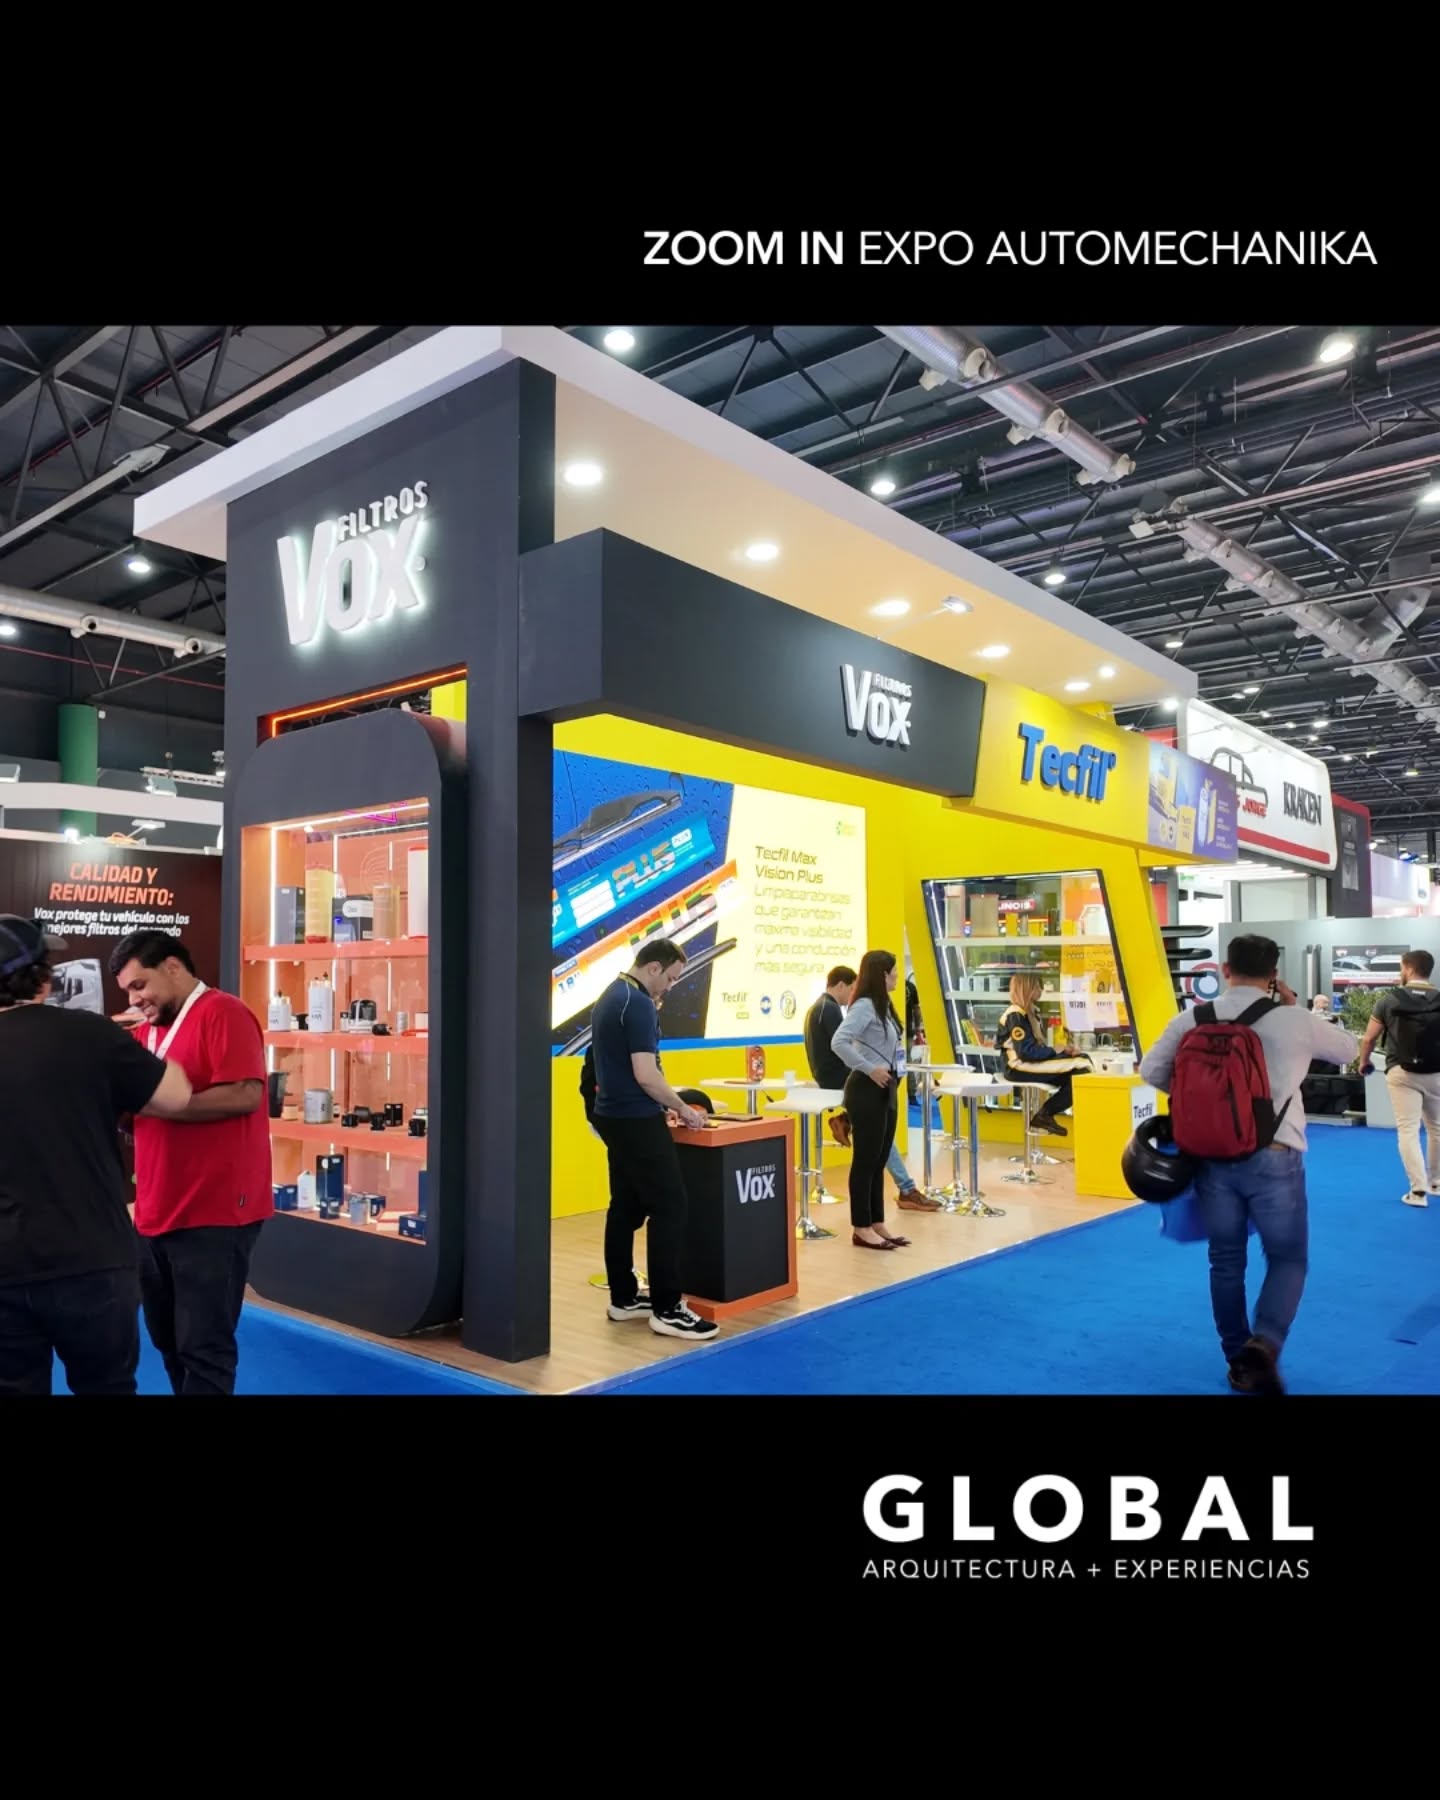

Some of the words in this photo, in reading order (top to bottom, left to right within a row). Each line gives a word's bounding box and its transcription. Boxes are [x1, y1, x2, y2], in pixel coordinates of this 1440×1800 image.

[337, 480, 429, 541] FILTROS
[871, 672, 913, 698] FILTROS
[1018, 722, 1112, 802] Tecfil
[1283, 781, 1322, 827] KRAKEN
[755, 845, 789, 863] Tecfil
[791, 850, 818, 865] Max
[70, 862, 143, 884] CALIDAD
[146, 867, 159, 885] Y
[755, 864, 795, 881] Vision
[796, 869, 824, 884] Plus
[49, 882, 175, 907] RENDIMIENTO:
[34, 907, 55, 919] Vox
[55, 908, 98, 923] protege
[99, 910, 111, 921] tu
[156, 913, 174, 924] con
[175, 912, 190, 925] los
[86, 923, 120, 937] filtros
